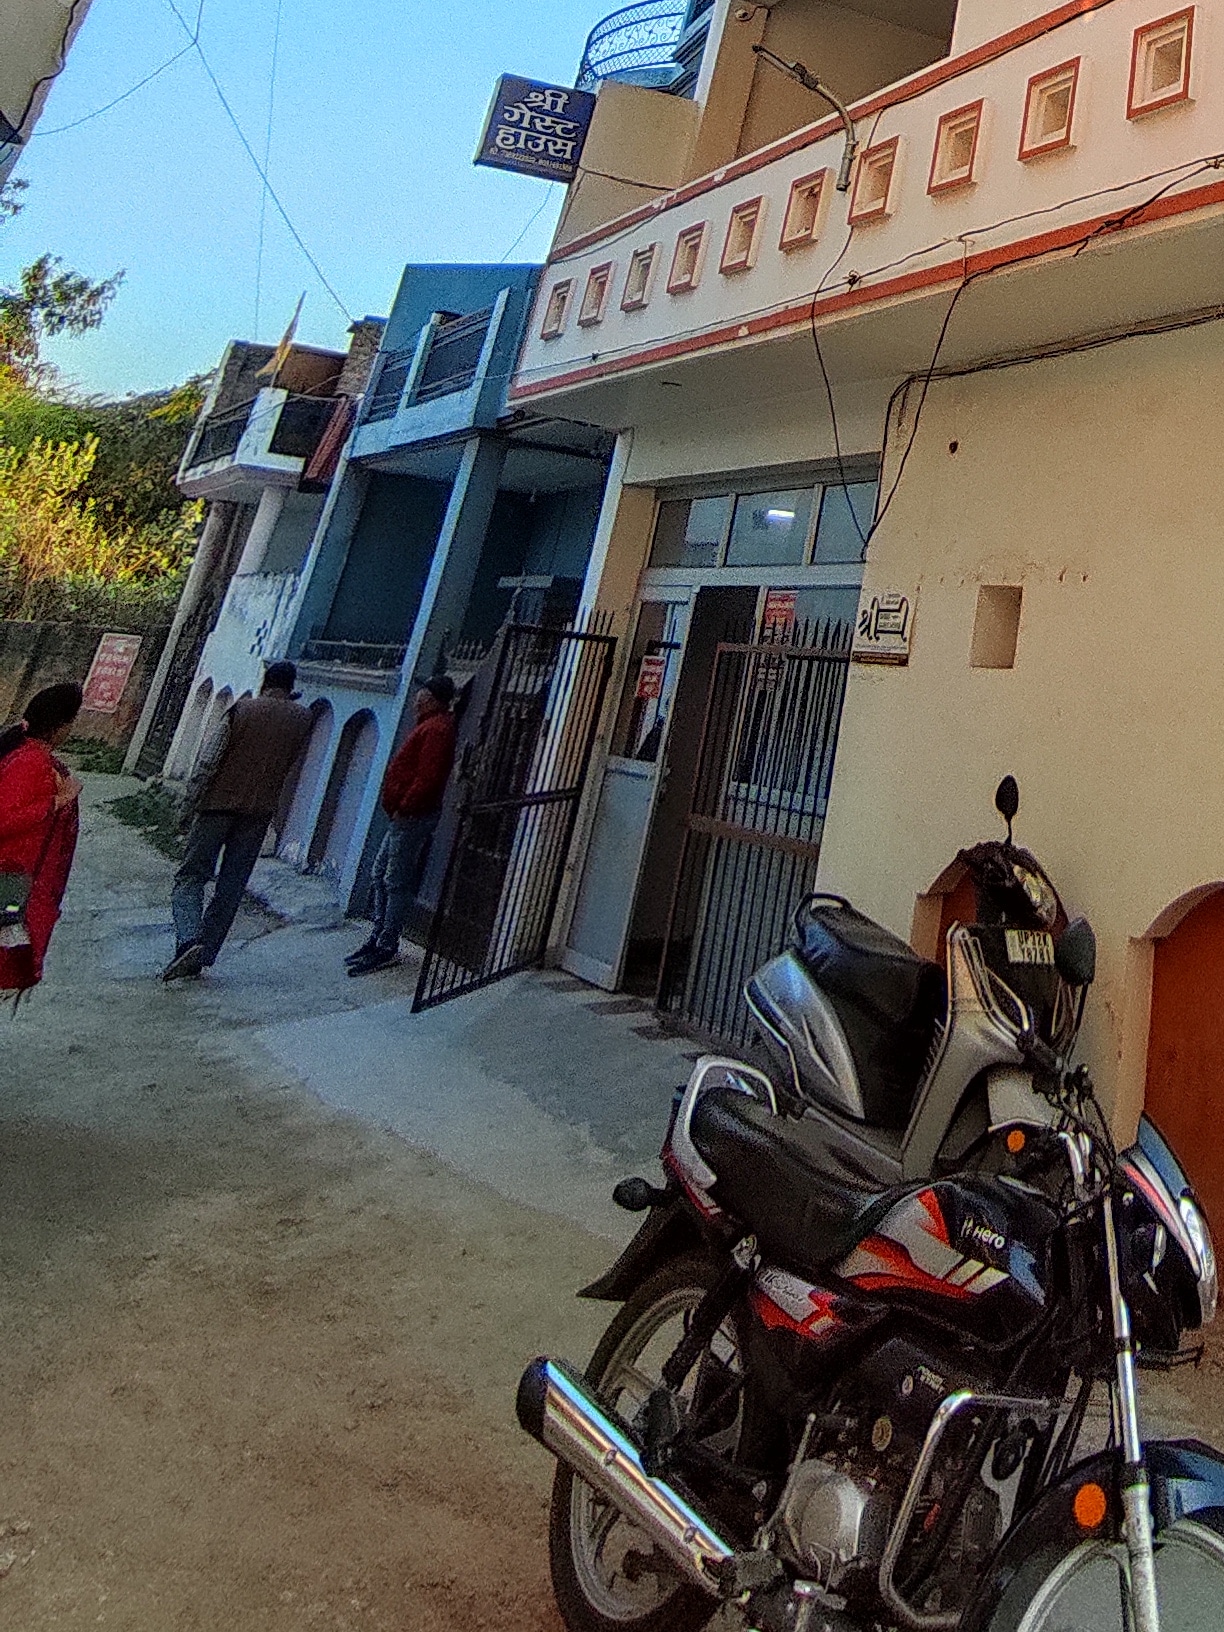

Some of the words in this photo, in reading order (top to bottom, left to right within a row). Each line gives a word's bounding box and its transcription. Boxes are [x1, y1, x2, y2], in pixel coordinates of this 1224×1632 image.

[524, 89, 570, 115] श्री
[503, 102, 580, 139] गेस्ट
[495, 124, 577, 160] हाउस
